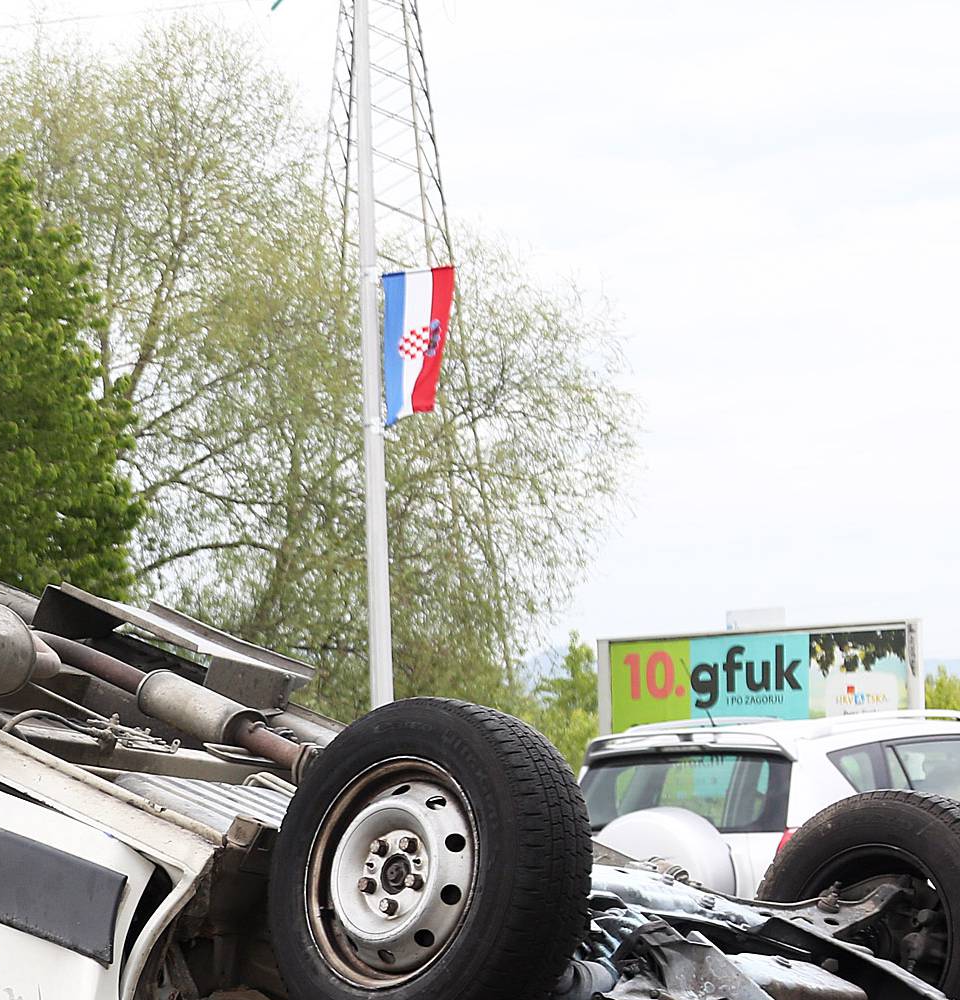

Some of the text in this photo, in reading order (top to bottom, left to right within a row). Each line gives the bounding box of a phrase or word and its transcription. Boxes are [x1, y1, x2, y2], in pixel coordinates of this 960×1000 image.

[623, 644, 802, 709] 10. gfuk
[744, 693, 784, 705] ZAGORJU
